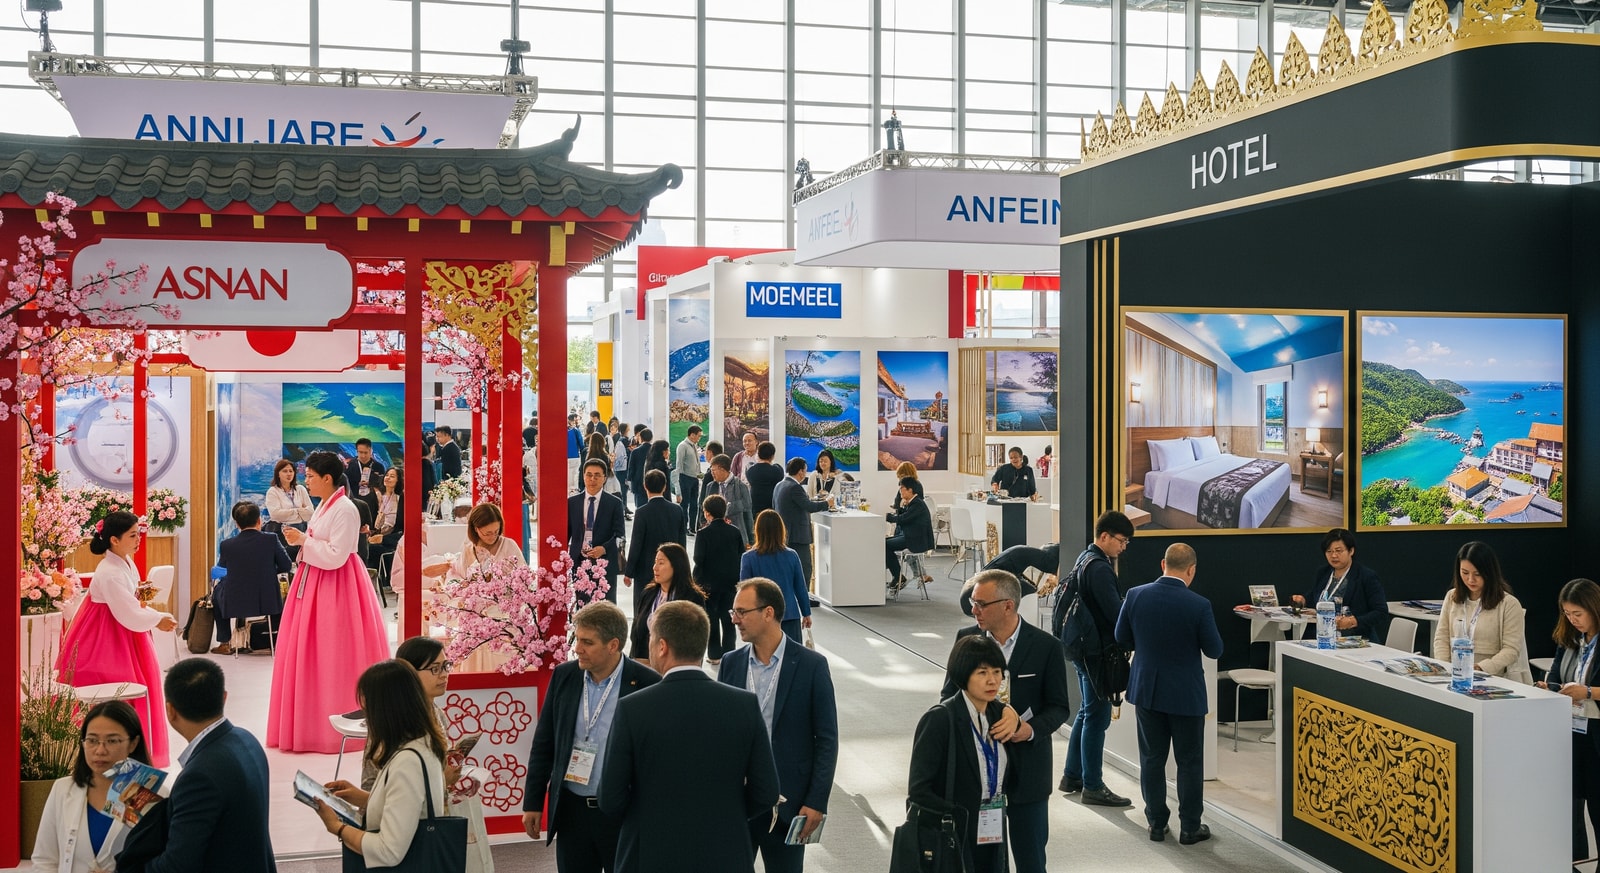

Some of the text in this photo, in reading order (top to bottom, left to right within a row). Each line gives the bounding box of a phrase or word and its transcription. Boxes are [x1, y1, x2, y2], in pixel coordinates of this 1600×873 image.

[1191, 133, 1277, 190] HOTEL
[152, 265, 288, 301] ASNAN
[750, 285, 839, 307] MOEMEEL
